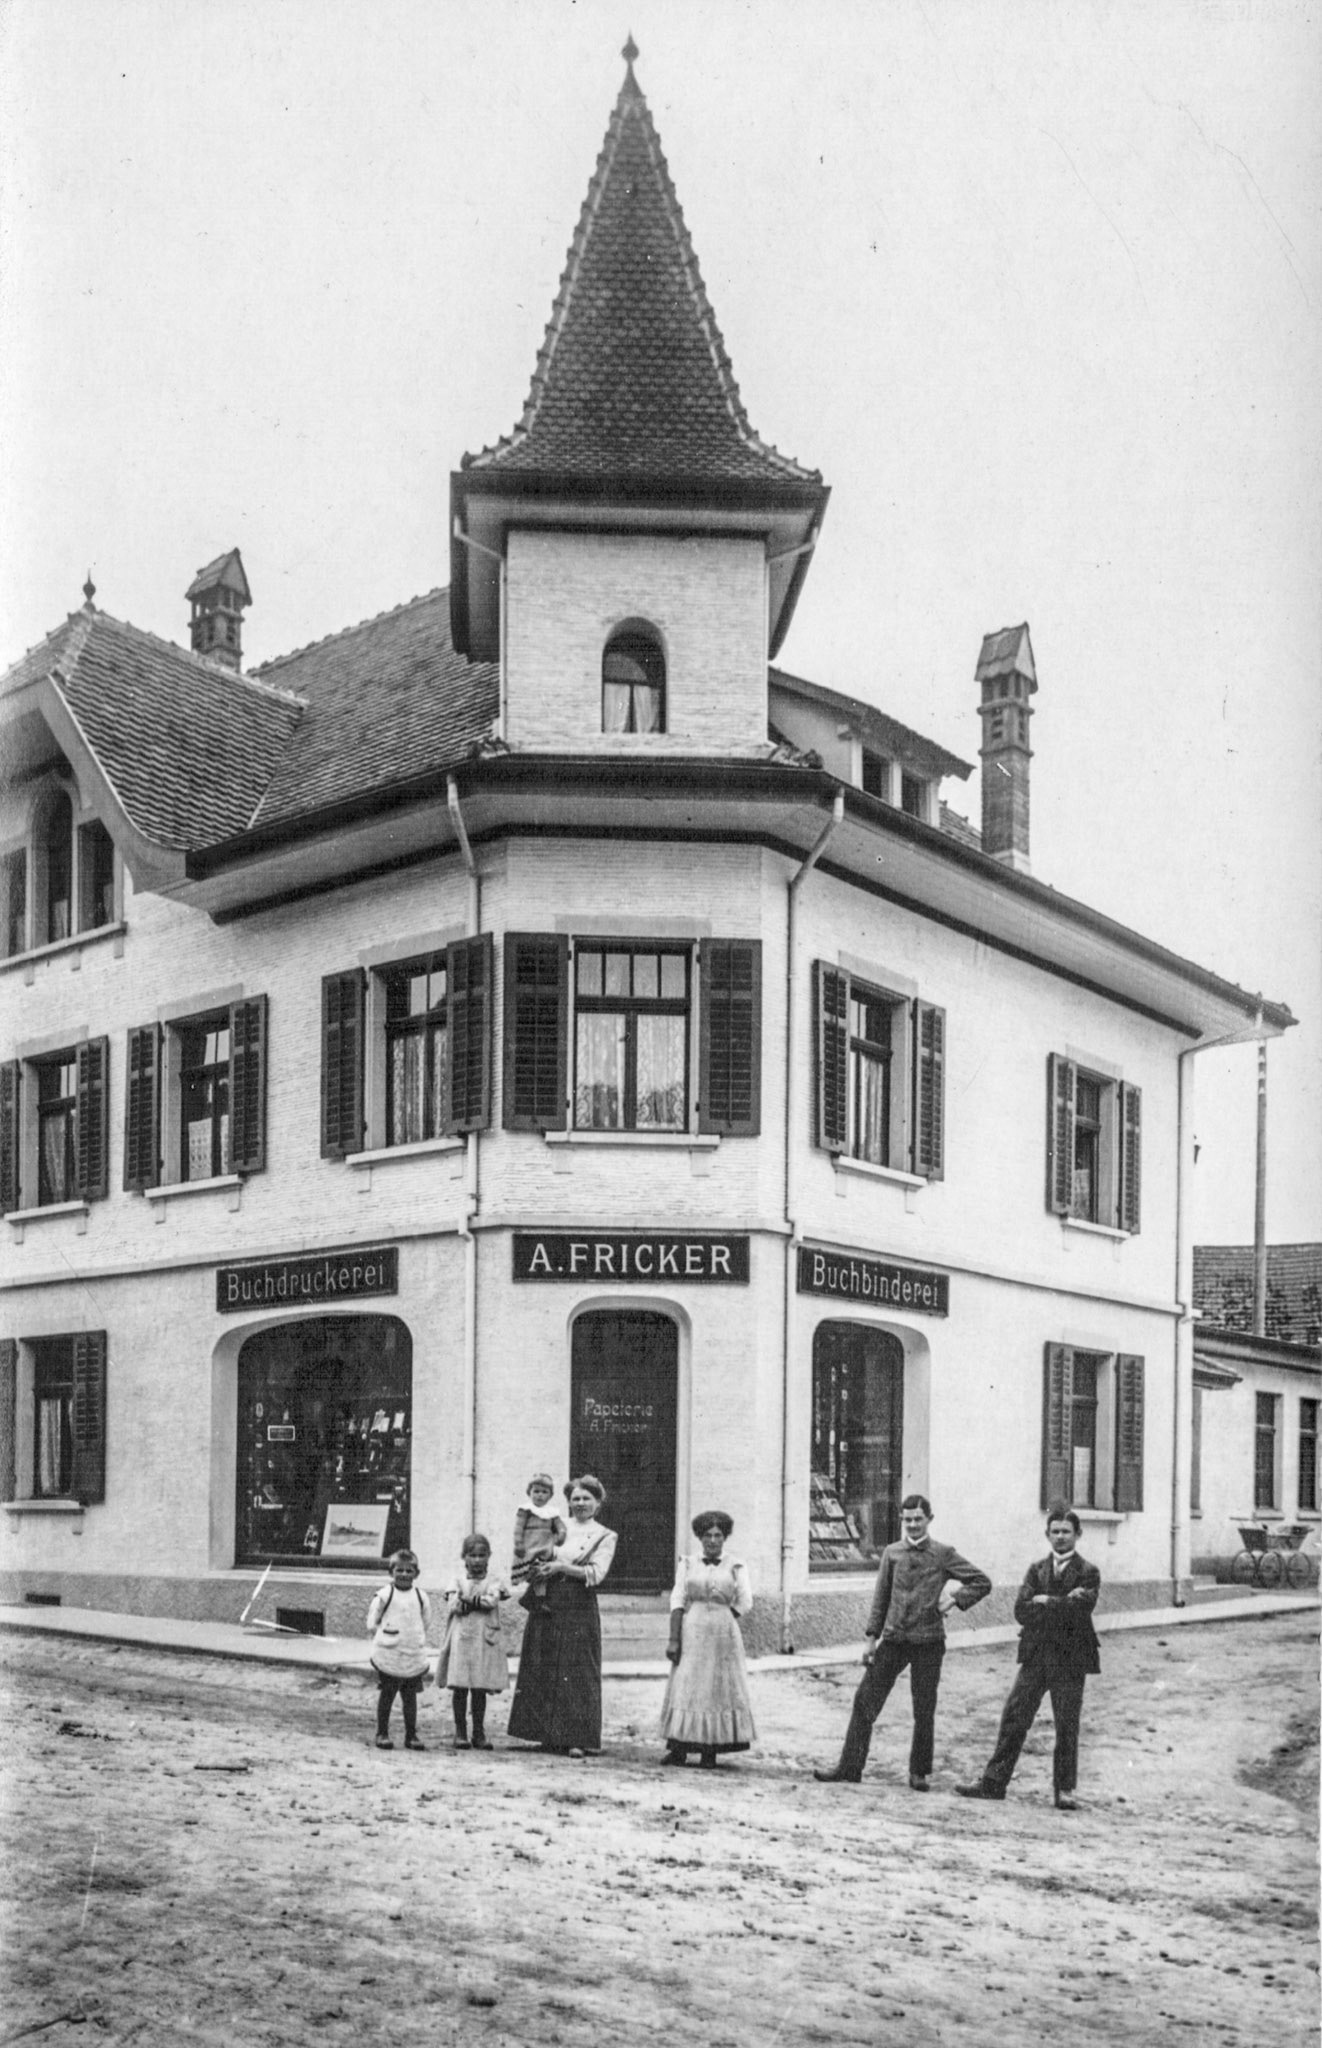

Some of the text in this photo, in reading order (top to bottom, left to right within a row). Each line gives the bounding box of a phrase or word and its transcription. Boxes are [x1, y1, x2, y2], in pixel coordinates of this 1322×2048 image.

[227, 1255, 384, 1302] Buchdruckerei
[813, 1254, 938, 1307] Buchbinderei
[584, 1398, 654, 1419] Papeterie
